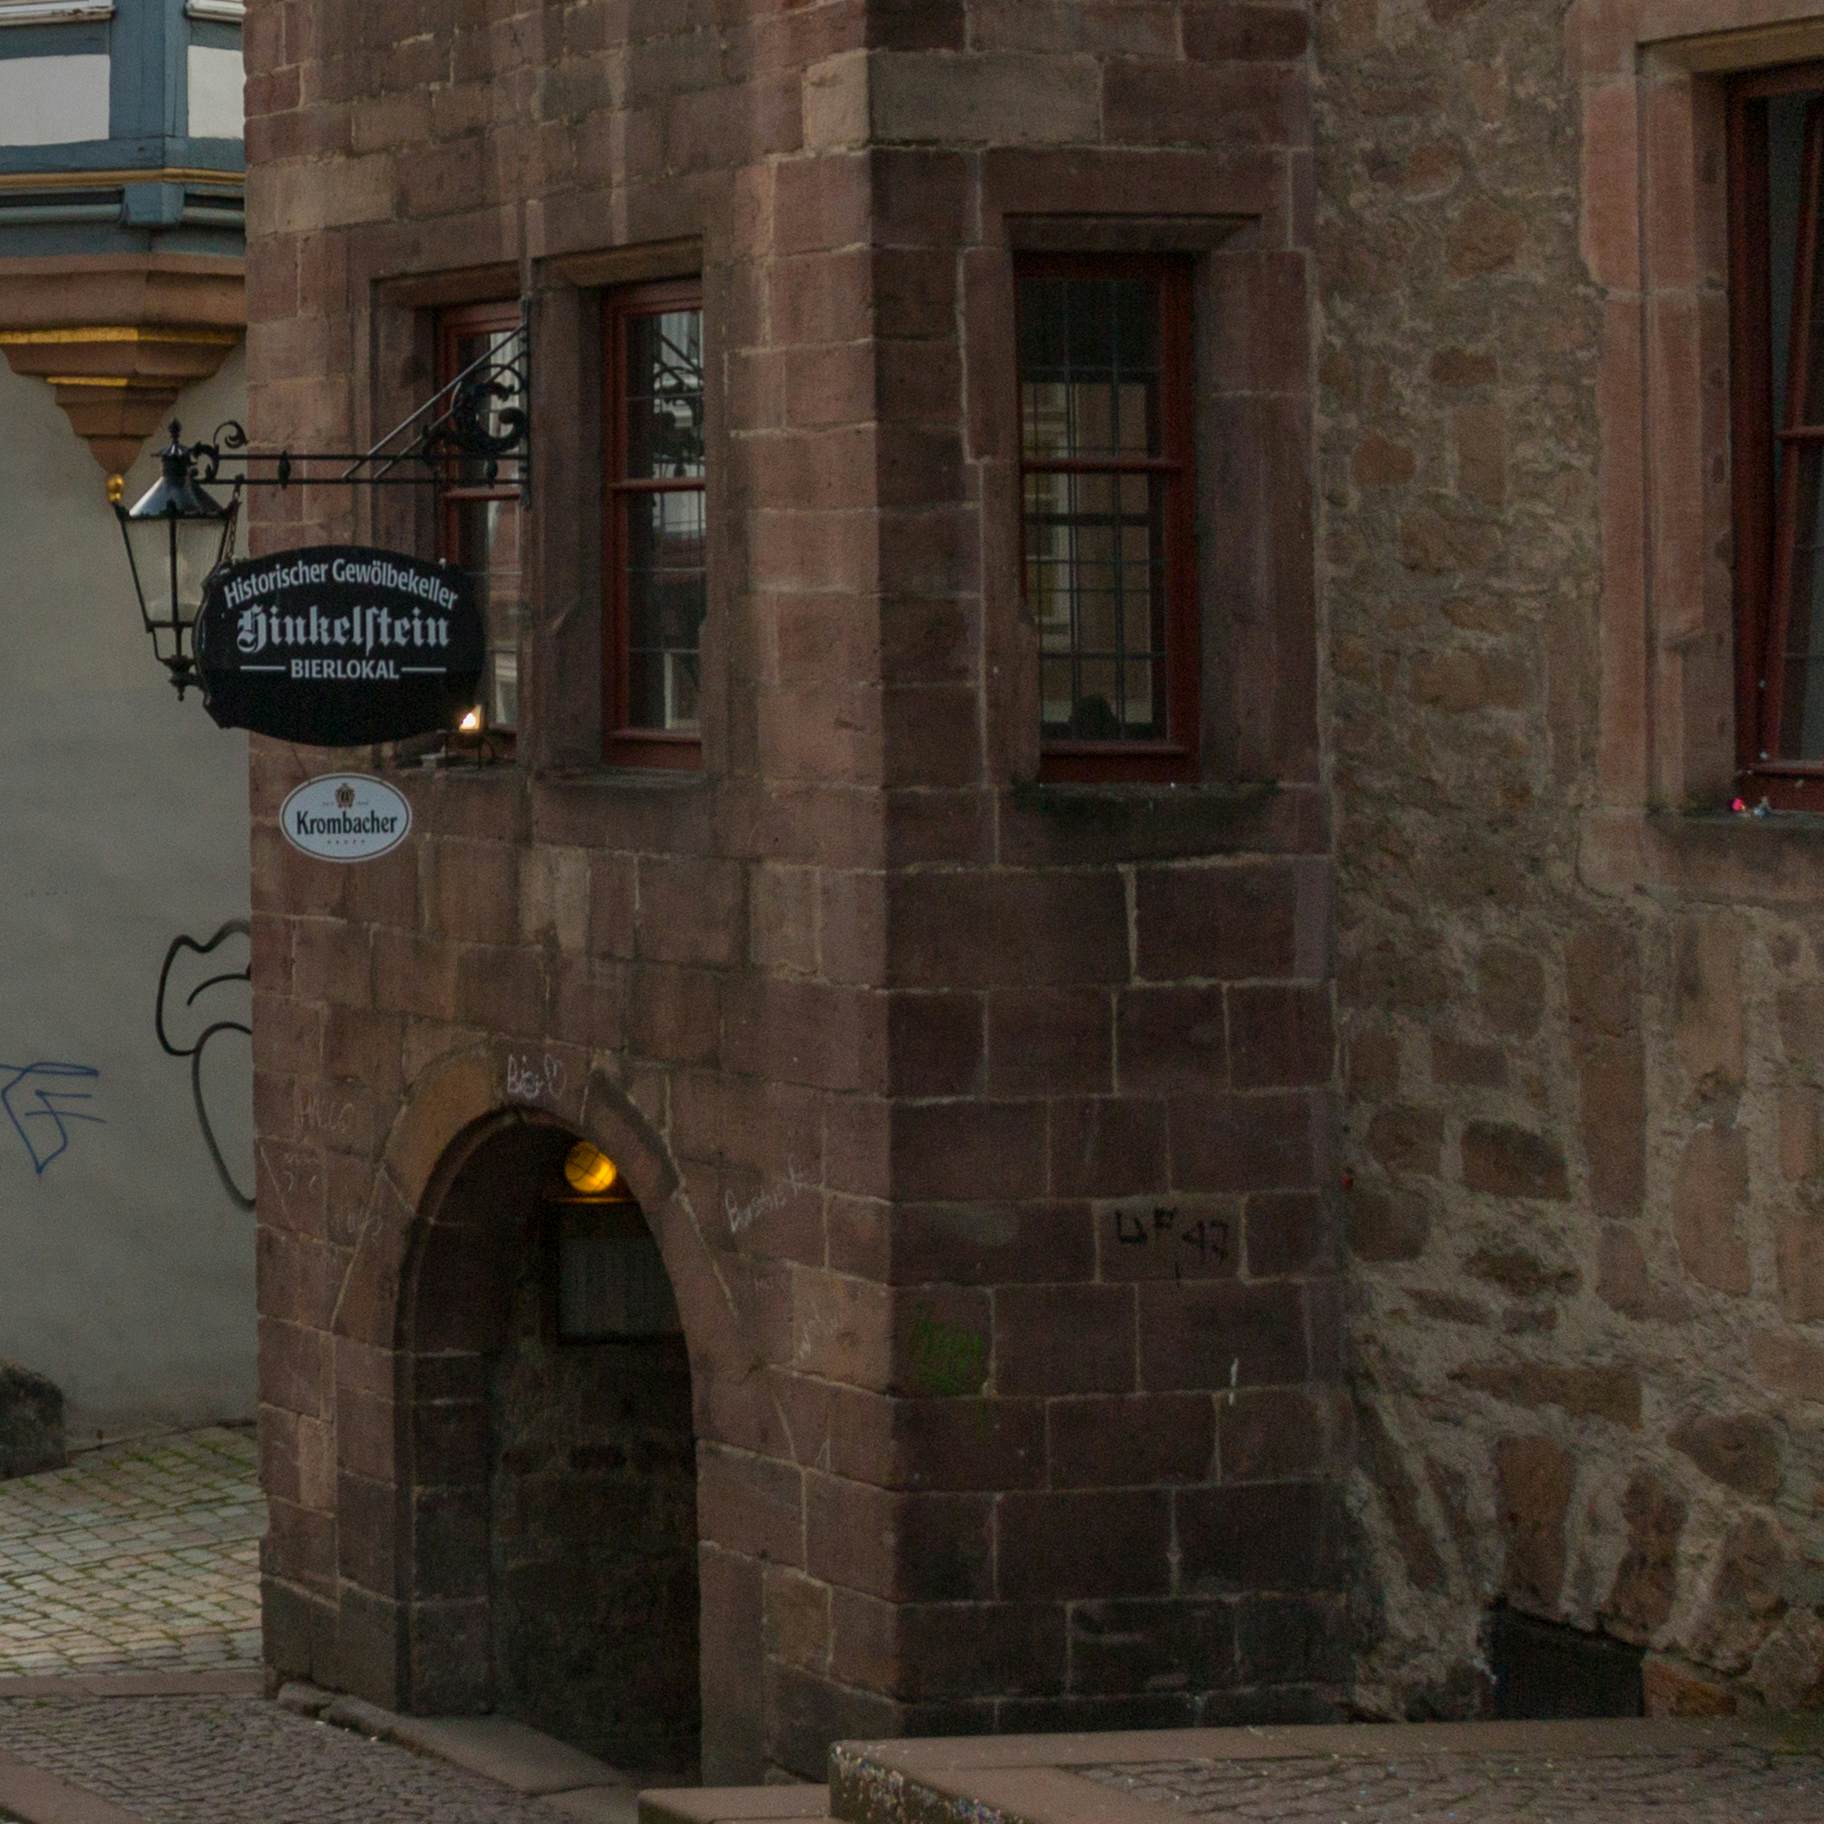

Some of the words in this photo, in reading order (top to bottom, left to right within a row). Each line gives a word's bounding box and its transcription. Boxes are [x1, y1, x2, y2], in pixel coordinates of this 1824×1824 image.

[223, 560, 329, 609] Historischer
[331, 558, 458, 611] Gewölbekeller
[290, 659, 400, 679] BIERLOKAL
[296, 809, 398, 835] Krombacher
